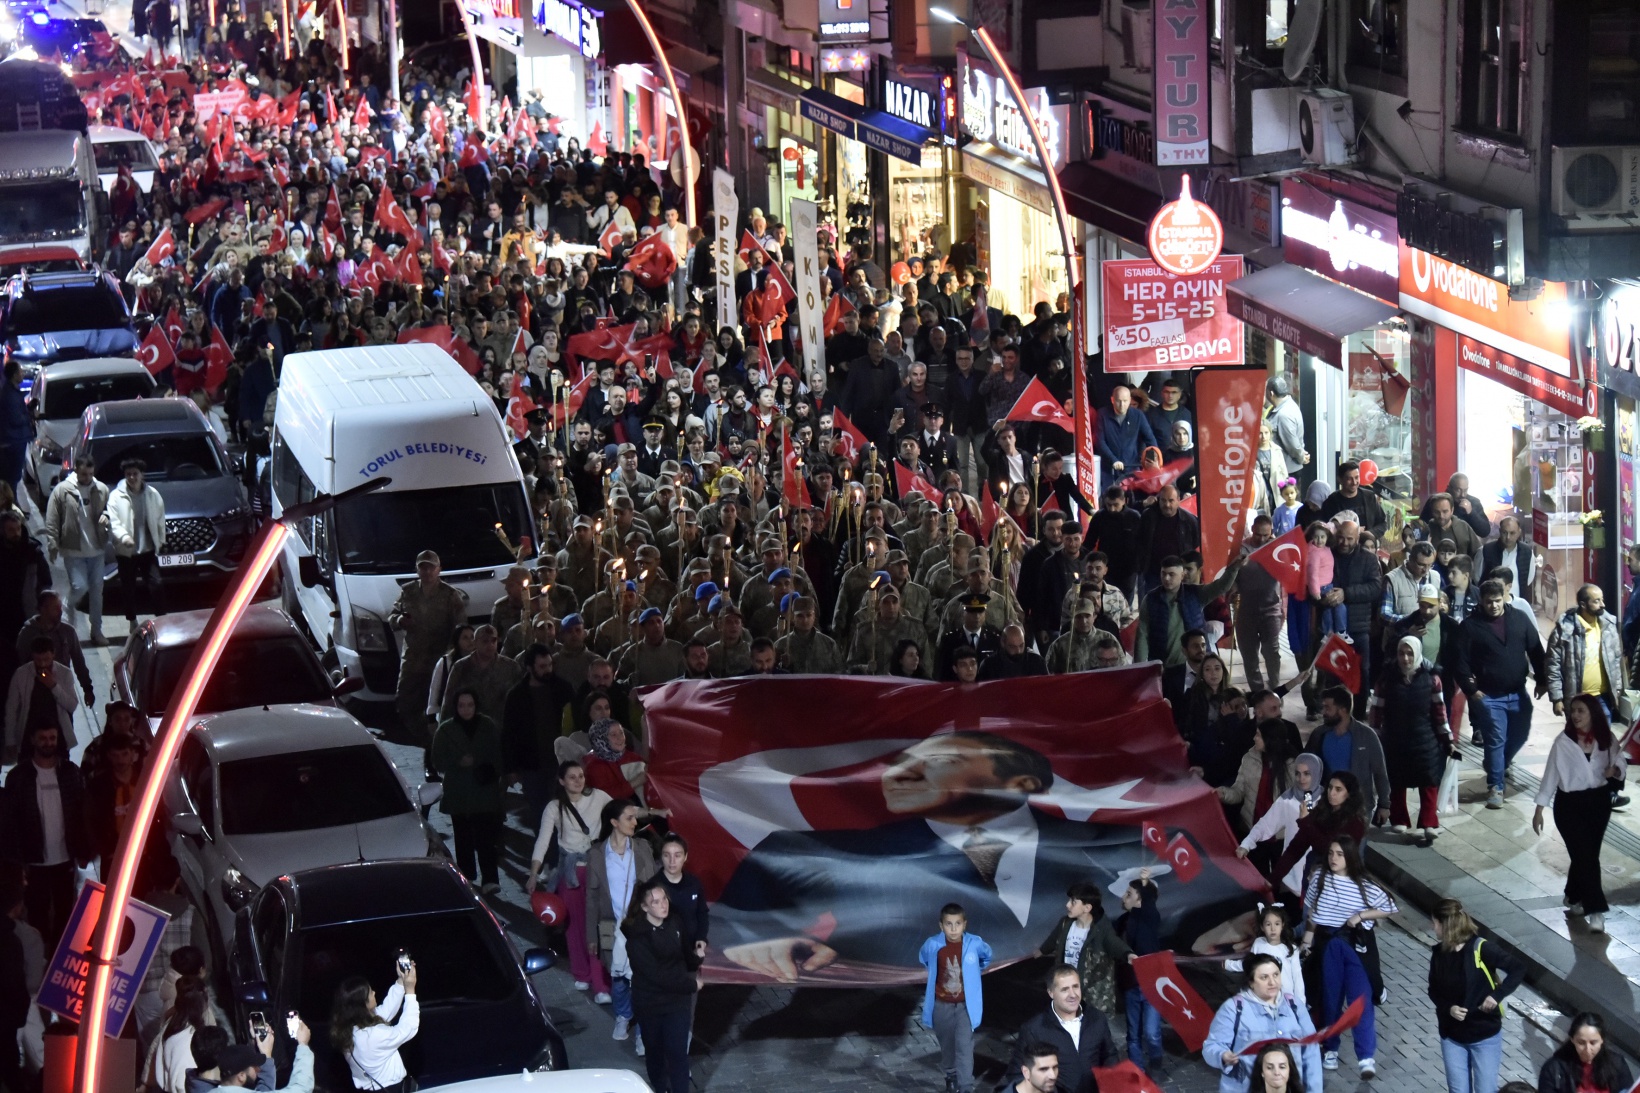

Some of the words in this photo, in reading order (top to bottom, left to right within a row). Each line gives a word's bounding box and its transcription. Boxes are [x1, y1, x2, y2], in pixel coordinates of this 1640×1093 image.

[886, 80, 931, 127] NAZAR
[808, 105, 829, 124] NAZAR
[830, 115, 847, 132] SHOP
[866, 130, 890, 150] NAZAR
[892, 141, 912, 158] SHOP
[1173, 149, 1206, 160] THY
[1125, 267, 1164, 278] İSTANBUL
[1430, 256, 1499, 313] vodafone
[1123, 281, 1167, 301] HER
[1173, 279, 1223, 300] AYIN
[1132, 300, 1215, 322] 5-15-25
[1242, 301, 1268, 330] İSTANBUL
[1155, 337, 1232, 365] BEDAVA
[1467, 352, 1490, 369] vodafone
[359, 449, 404, 478] TORUL
[405, 442, 488, 465] BELEDİYESİ
[1218, 405, 1246, 556] odafone
[178, 554, 193, 564] 209
[63, 955, 129, 994] İNDME
[51, 970, 128, 1013] BİNDME
